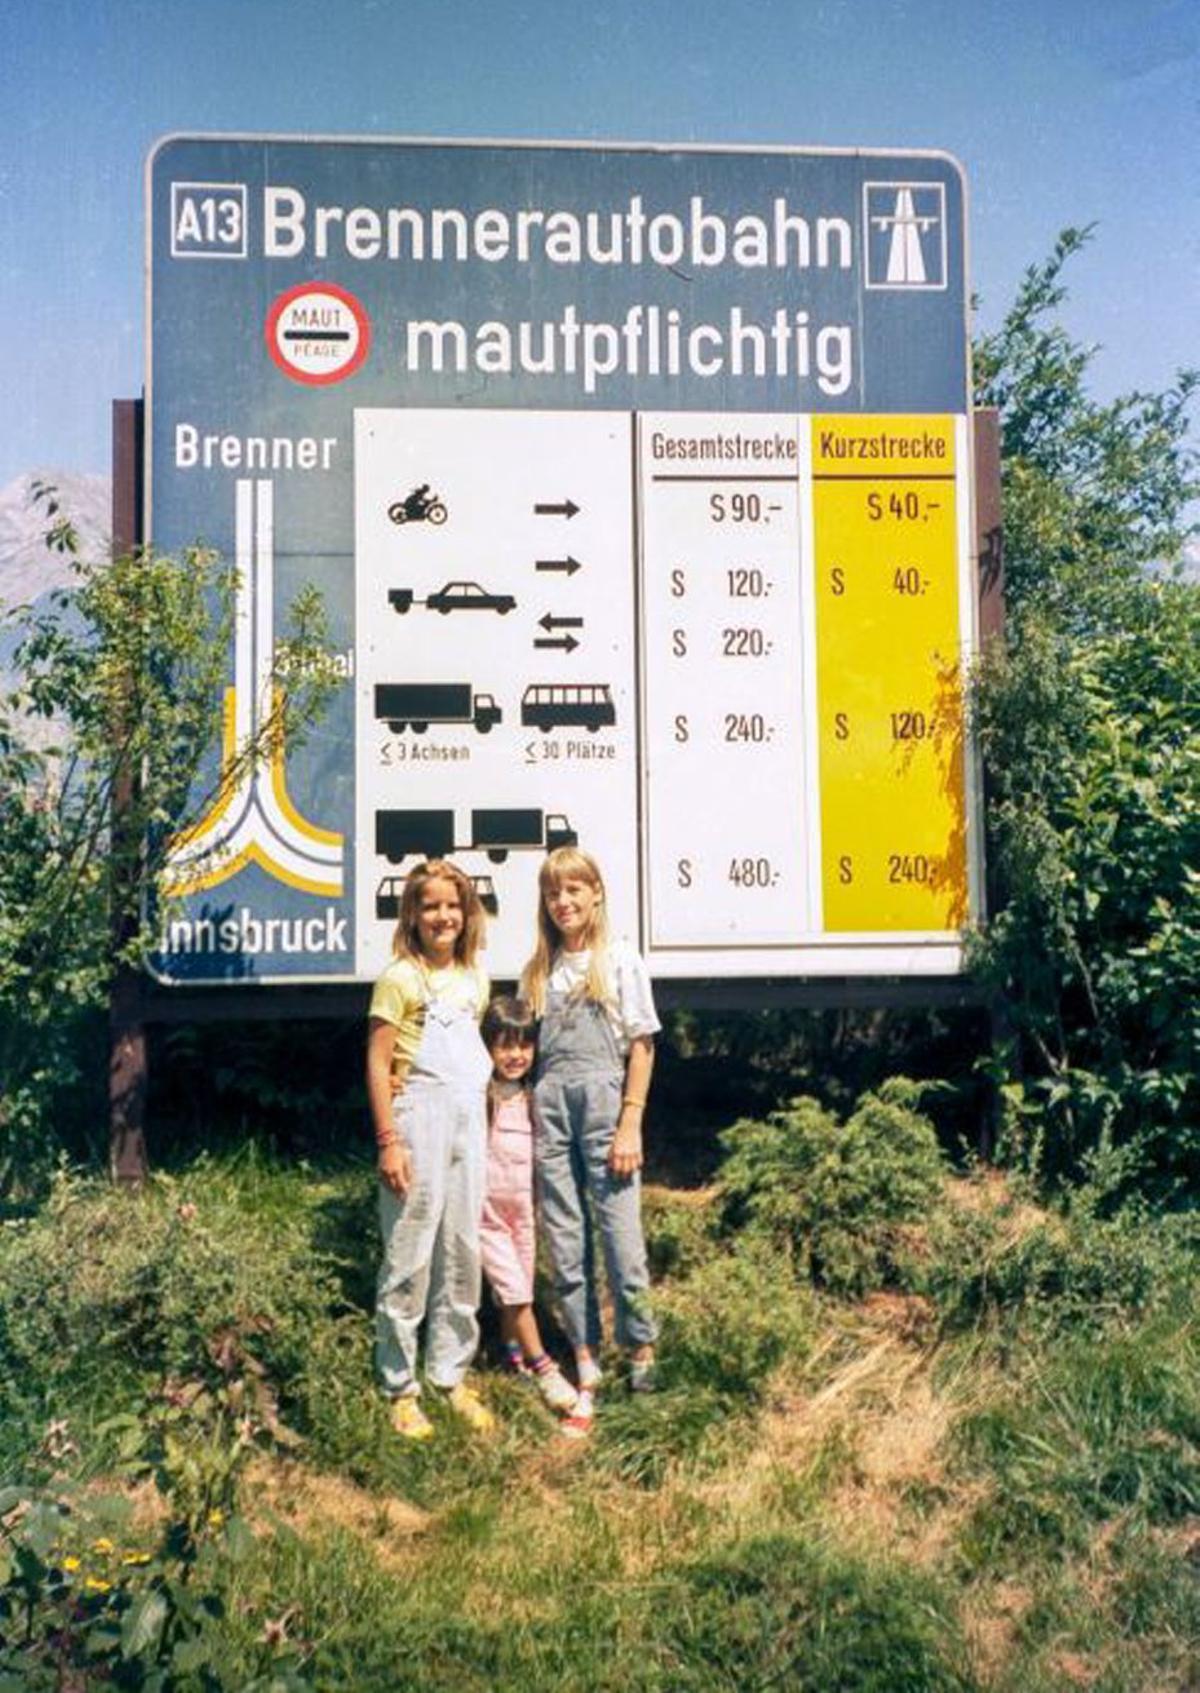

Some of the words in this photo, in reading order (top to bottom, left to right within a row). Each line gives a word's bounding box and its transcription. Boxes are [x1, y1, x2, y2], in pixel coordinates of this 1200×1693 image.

[176, 198, 242, 243] A13
[264, 186, 852, 269] Brennerautobahn
[292, 308, 341, 327] MAUT
[406, 305, 853, 395] mautpflichtig
[175, 424, 338, 469] Brenner
[652, 432, 798, 459] Gesamtstrecke
[820, 432, 946, 458] Kurzstrecke
[672, 569, 685, 597] S
[831, 567, 845, 595] S
[673, 629, 687, 657] S
[675, 715, 689, 743] S
[835, 712, 849, 740] S
[411, 742, 470, 760] Achsen
[542, 741, 560, 759] 30
[567, 740, 616, 759] Plätze
[678, 859, 692, 889] S
[839, 856, 852, 884] S
